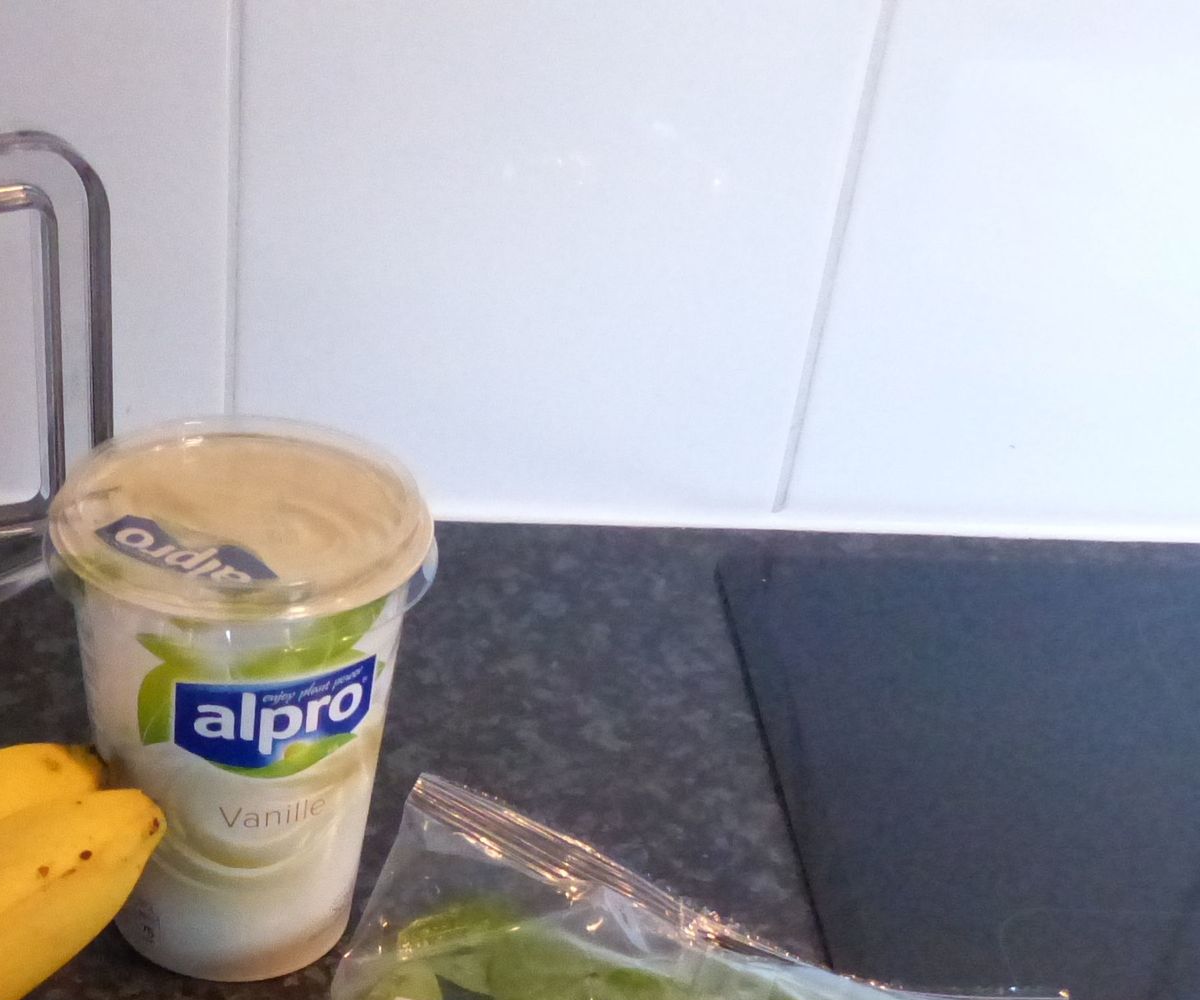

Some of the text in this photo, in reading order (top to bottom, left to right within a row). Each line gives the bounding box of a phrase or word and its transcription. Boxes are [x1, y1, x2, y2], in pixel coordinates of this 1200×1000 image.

[115, 527, 252, 585] alpro
[193, 682, 363, 755] alpro
[218, 797, 327, 829] Vanille
